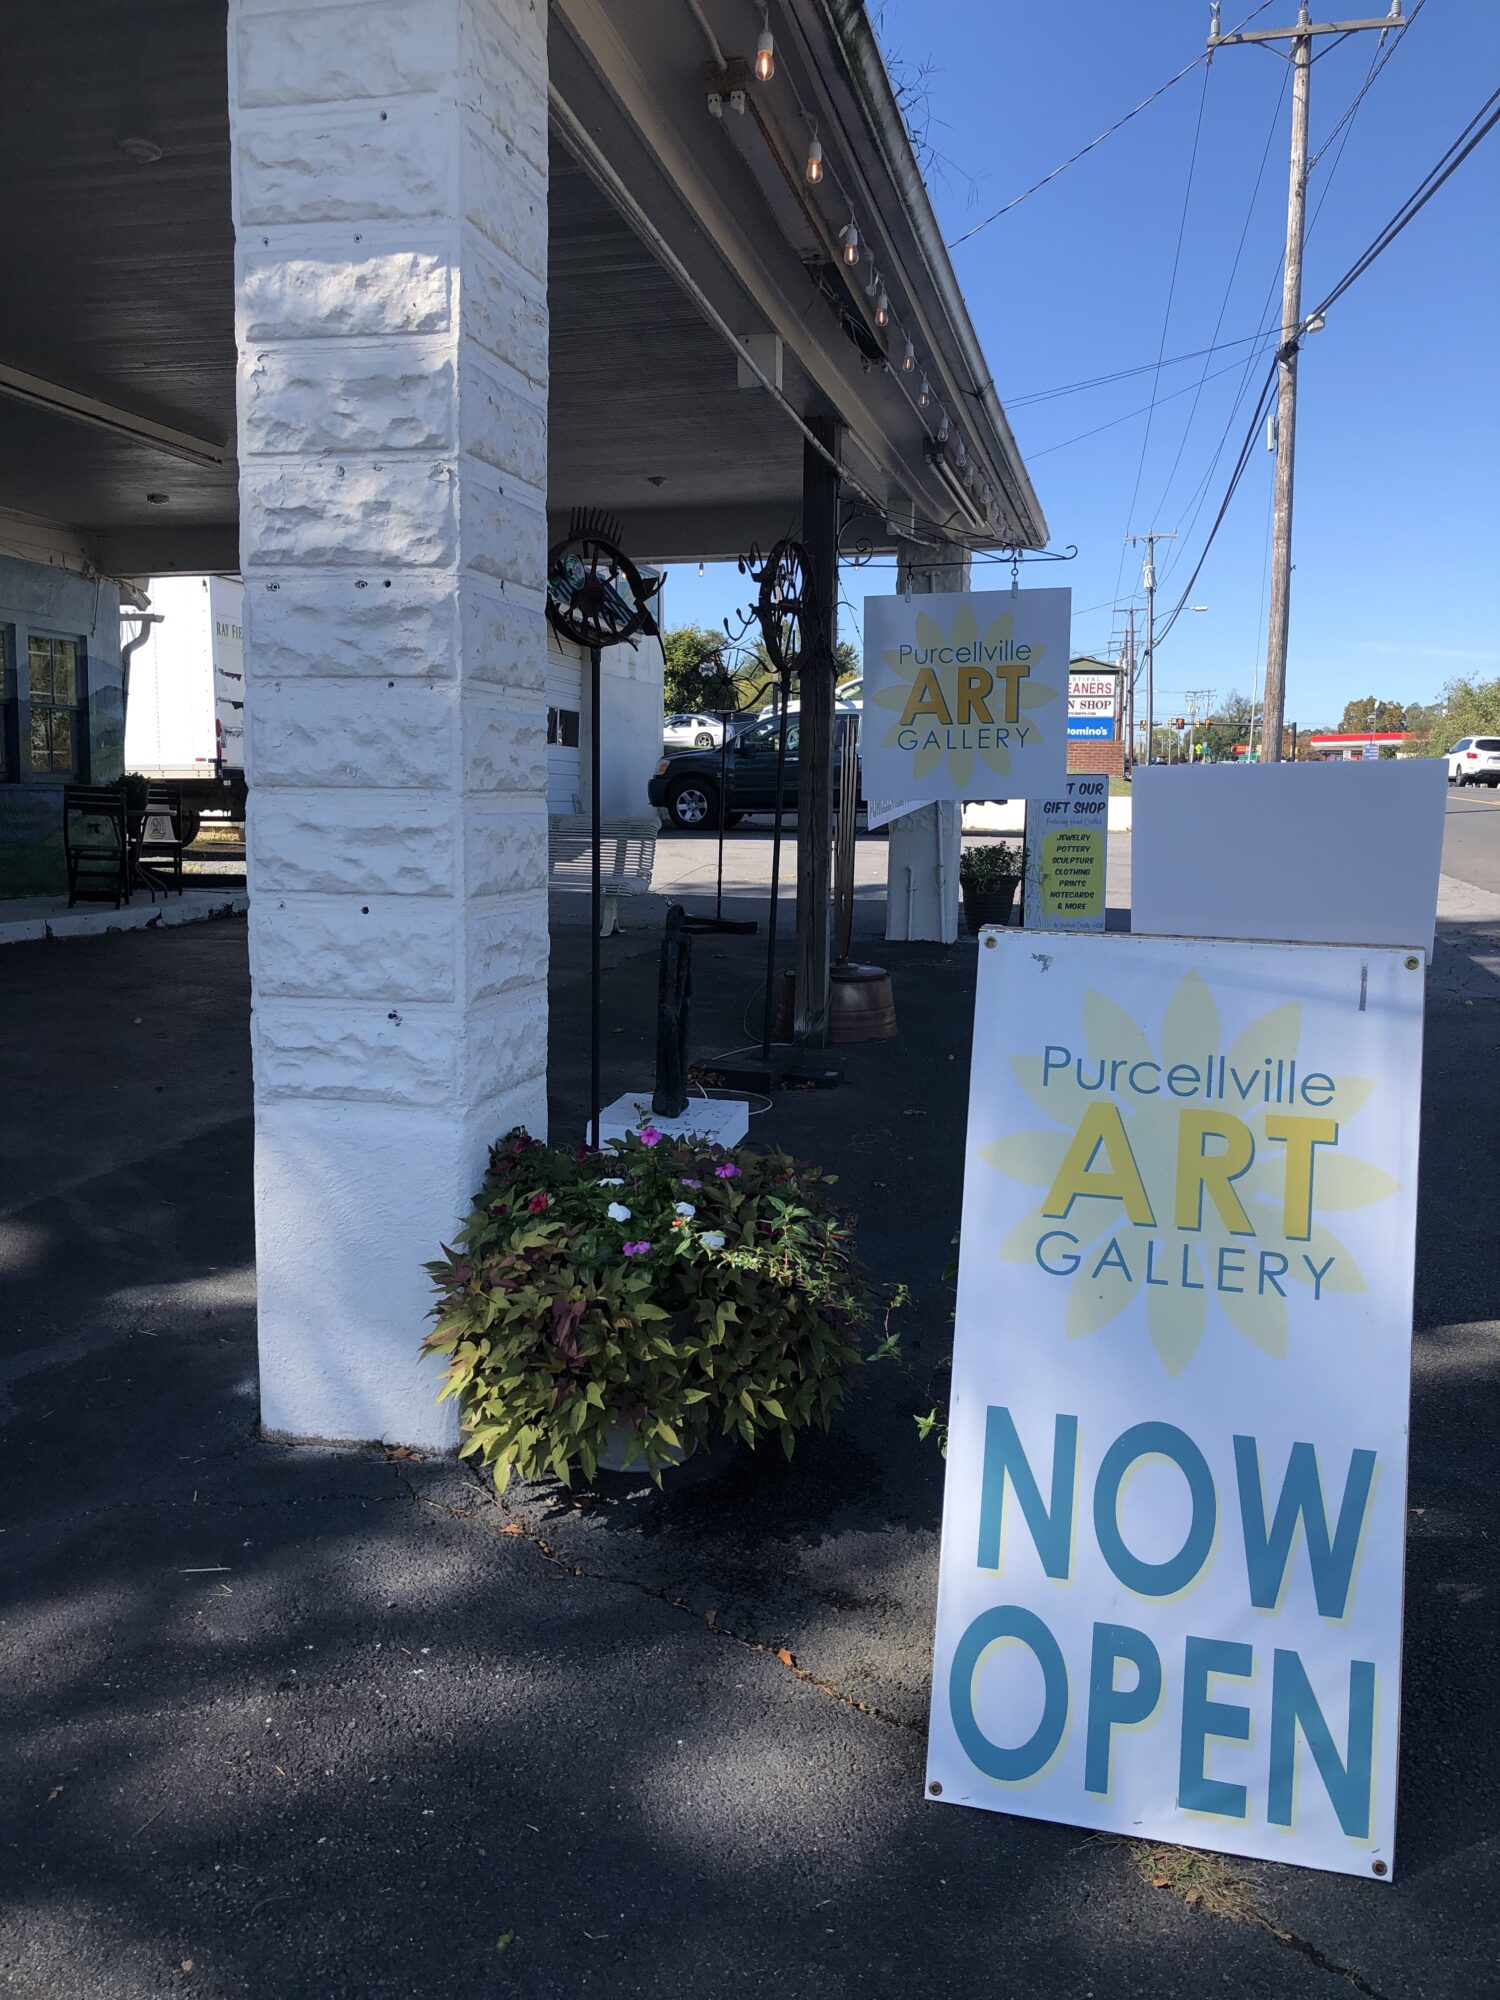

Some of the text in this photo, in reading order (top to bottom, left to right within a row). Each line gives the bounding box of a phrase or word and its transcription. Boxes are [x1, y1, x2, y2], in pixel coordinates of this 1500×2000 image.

[899, 640, 1032, 665] Purcellville
[899, 665, 1031, 727] ART
[1080, 700, 1112, 710] SHOP
[897, 727, 1030, 751] GALLERY
[1078, 783, 1104, 795] OUR
[1043, 801, 1106, 814] GIFT SHOP
[1052, 857, 1094, 865] SCULPTURE
[1056, 845, 1091, 853] POTTERY
[1050, 891, 1095, 899] NOTECARDS
[1042, 1045, 1336, 1107] Purcellville
[1040, 1102, 1339, 1242] ART
[1035, 1230, 1336, 1301] GALLERY
[976, 1404, 1379, 1620] NOW
[949, 1604, 1379, 1841] OPEN
